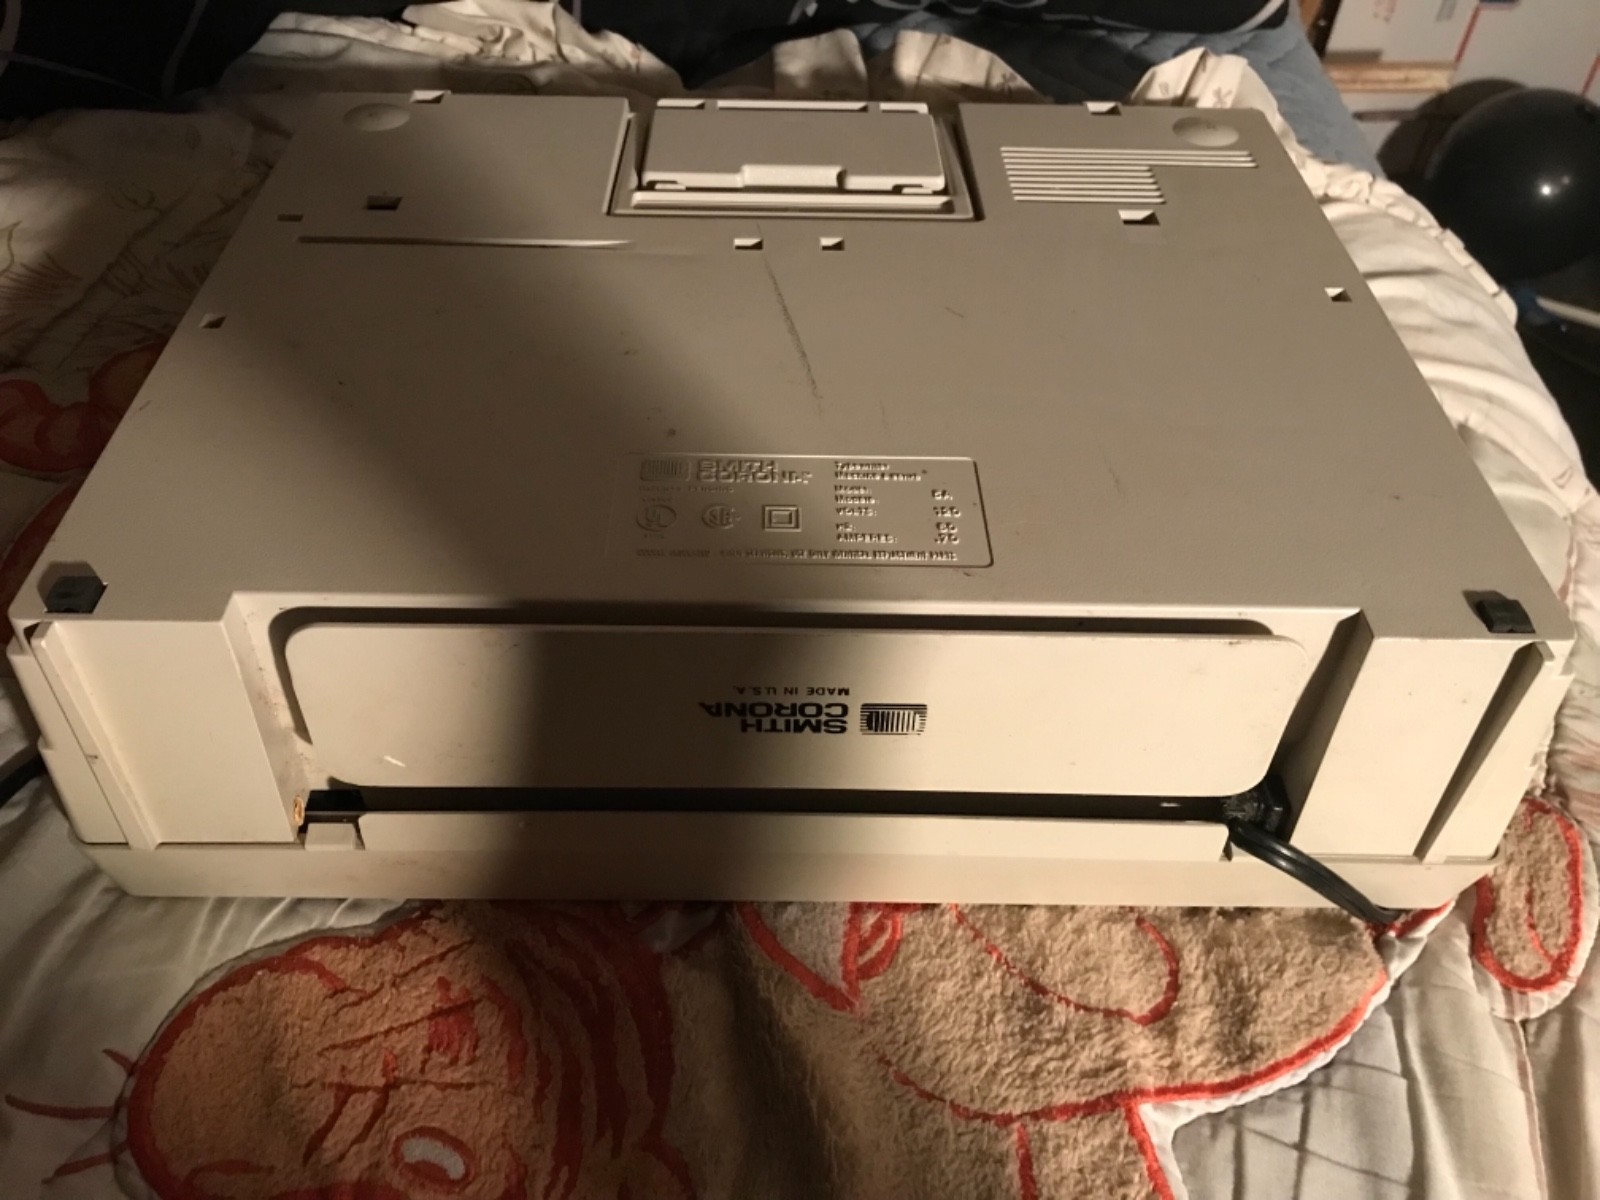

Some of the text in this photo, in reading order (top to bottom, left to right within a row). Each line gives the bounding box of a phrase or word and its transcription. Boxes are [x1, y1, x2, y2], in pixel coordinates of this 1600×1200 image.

[732, 686, 850, 696] MADE IN U.S.A.
[698, 702, 850, 718] CORONA
[740, 718, 849, 734] SMITH
